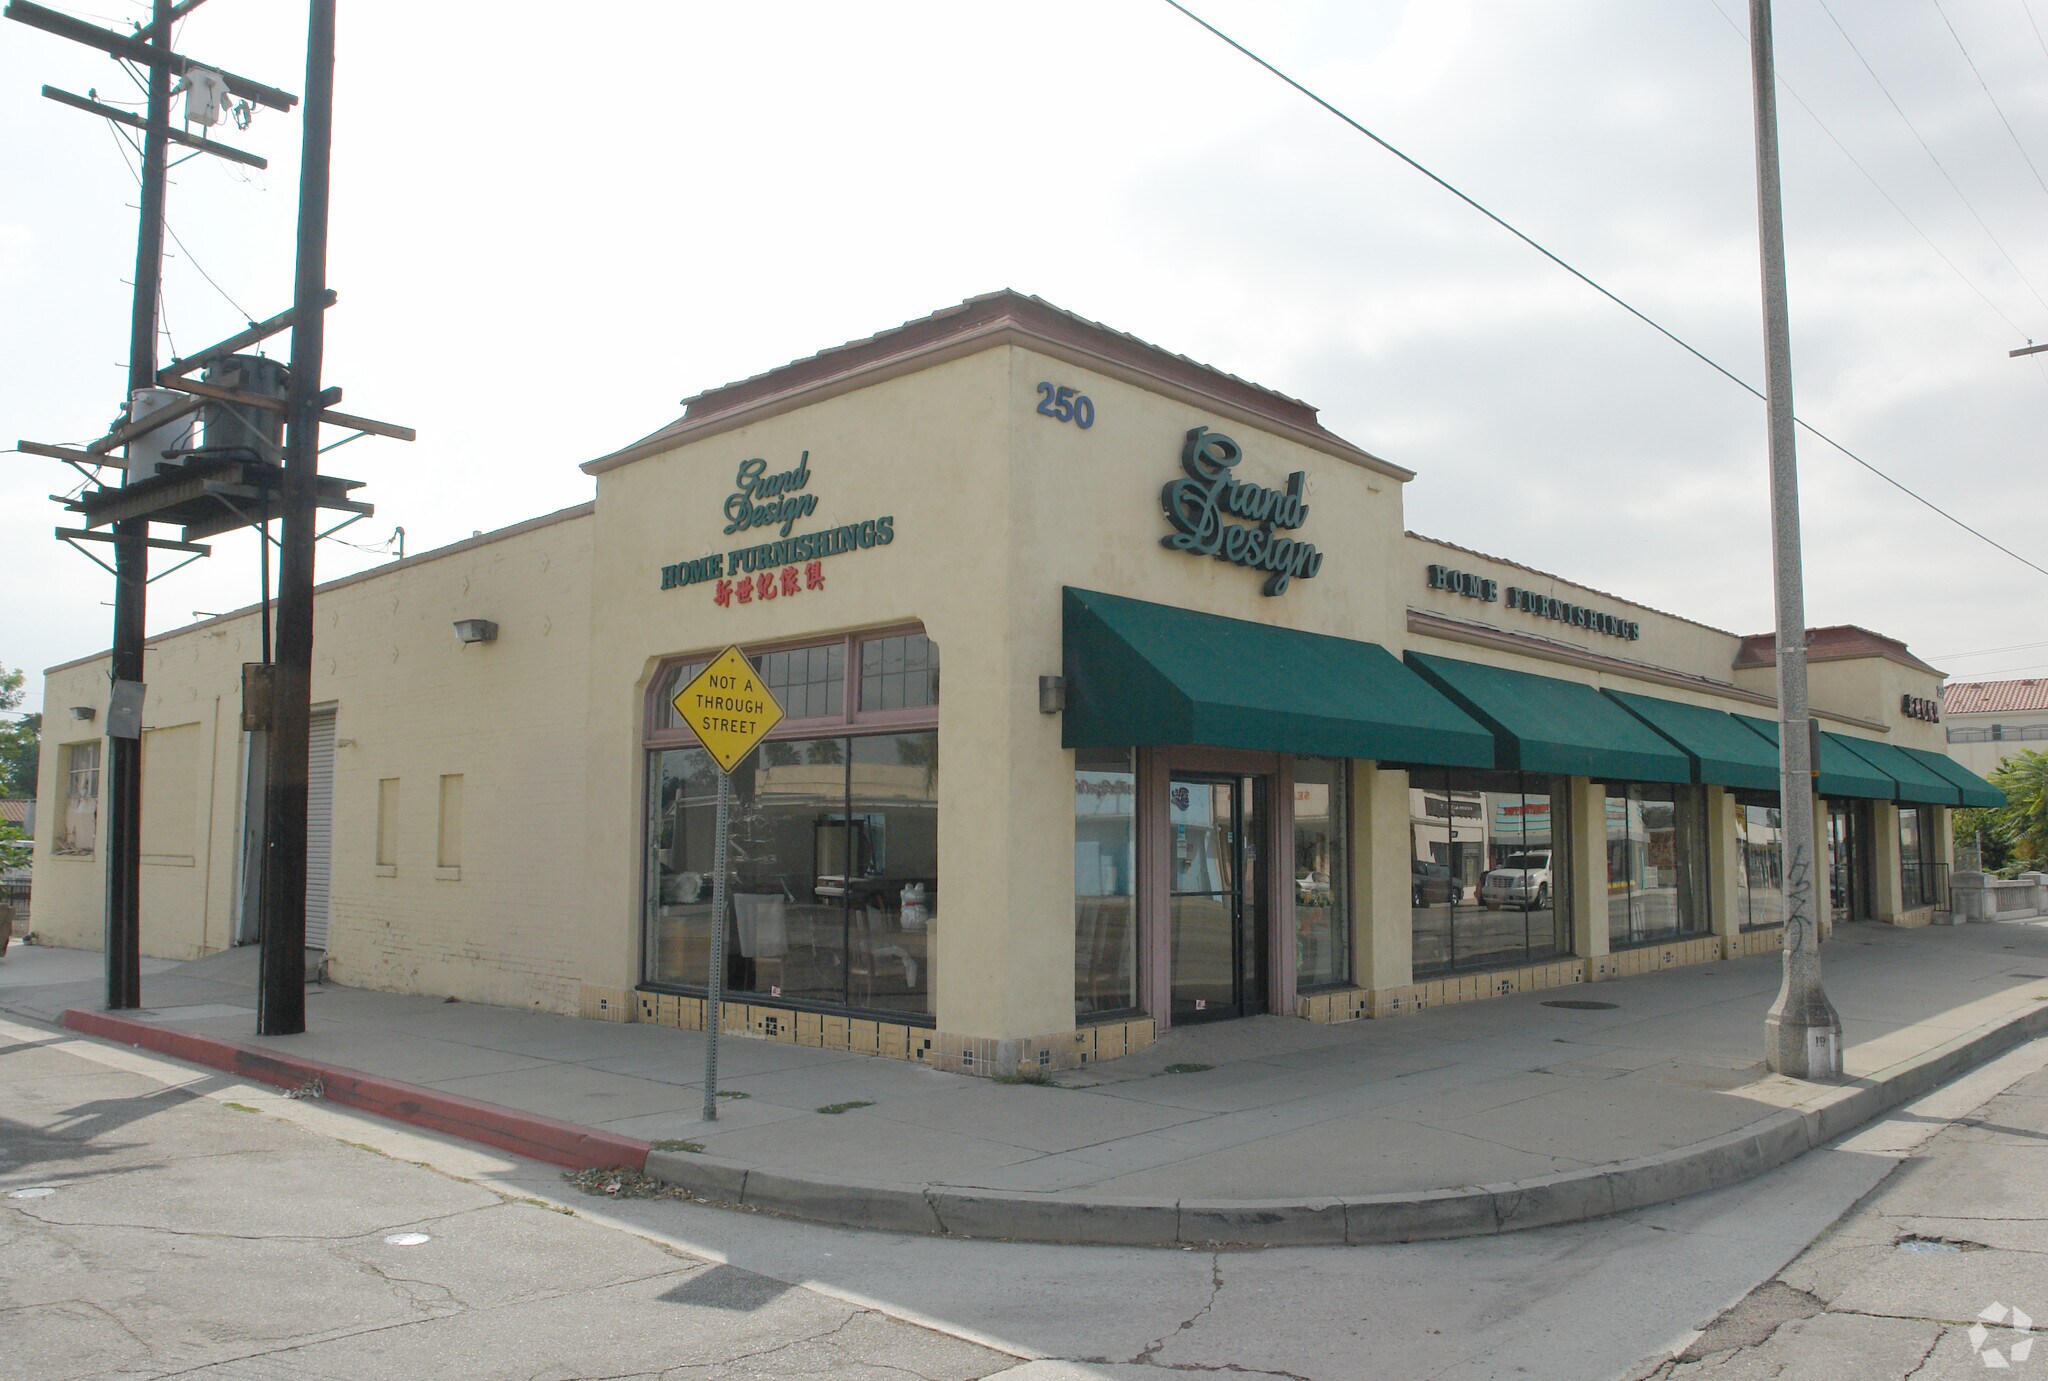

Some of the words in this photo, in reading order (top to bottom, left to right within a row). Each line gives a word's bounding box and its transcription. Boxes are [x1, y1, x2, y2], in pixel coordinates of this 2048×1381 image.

[1036, 381, 1095, 429] 250
[736, 450, 811, 501] Grand
[1181, 425, 1310, 530] Grand
[723, 492, 819, 537] Design
[1160, 477, 1324, 597] Design
[661, 553, 723, 590] HOME
[727, 516, 895, 576] FURNISHINGS
[1427, 564, 1499, 602] HOME
[1505, 586, 1640, 641] FURNISHINGS
[696, 694, 764, 714] THROUGH
[708, 675, 737, 690] NOT
[743, 679, 754, 693] A
[702, 716, 757, 735] STREET
